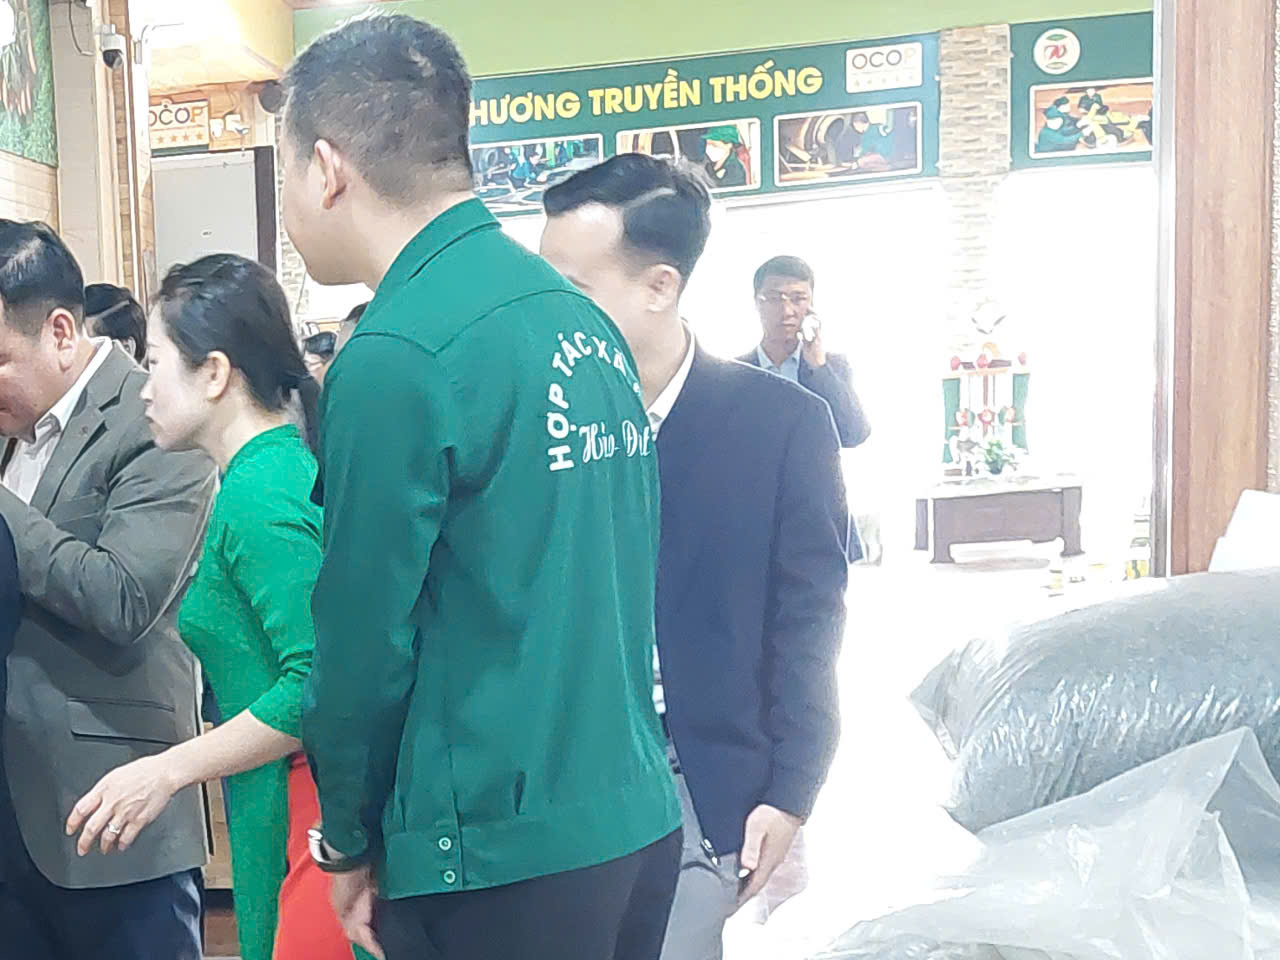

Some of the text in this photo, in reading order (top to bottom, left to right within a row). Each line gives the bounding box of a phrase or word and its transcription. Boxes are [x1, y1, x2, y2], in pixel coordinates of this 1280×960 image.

[588, 68, 702, 116] TRUYỀN
[709, 59, 824, 104] THỐNG
[552, 331, 593, 377] TÁC
